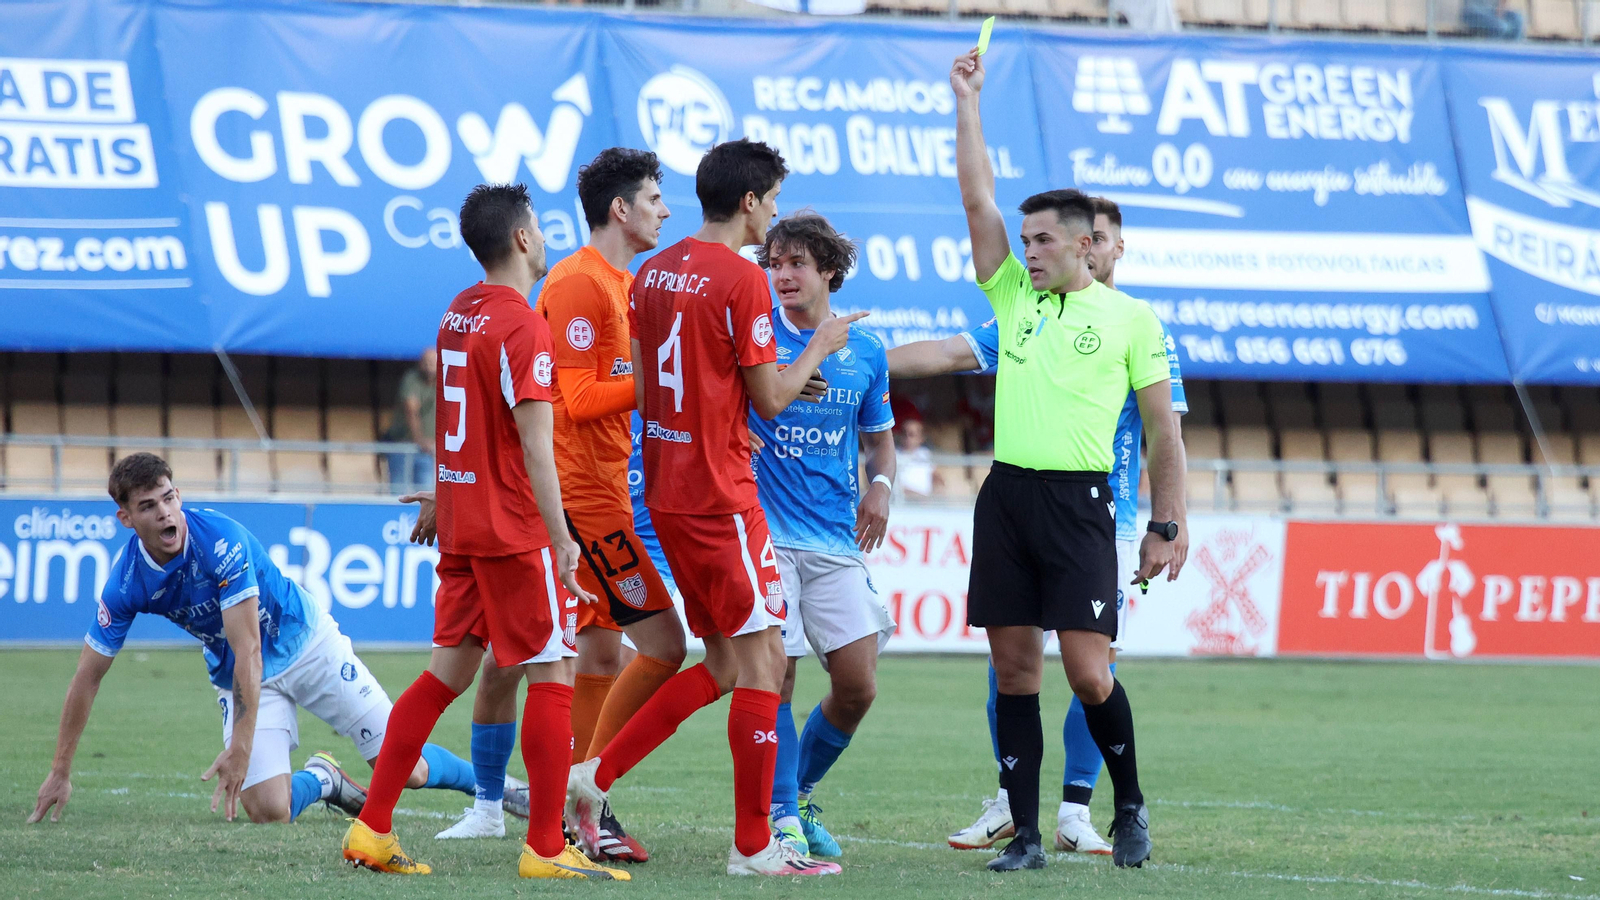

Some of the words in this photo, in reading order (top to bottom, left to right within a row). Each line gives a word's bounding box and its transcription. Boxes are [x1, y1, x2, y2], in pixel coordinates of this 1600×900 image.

[43, 71, 115, 110] DE
[752, 76, 954, 116] RECAMBIOS
[1156, 58, 1257, 138] AT
[1258, 62, 1413, 108] GREEN
[189, 73, 592, 194] GROW
[845, 114, 957, 179] GALVE
[1261, 102, 1413, 144] ENERGY
[1152, 142, 1214, 195] 0,0
[203, 202, 372, 298] UP
[865, 234, 922, 282] 01
[1124, 250, 1262, 274] TALACIONES
[657, 311, 684, 414] 4
[441, 348, 468, 453] 5
[814, 406, 843, 416] Resorts
[774, 423, 847, 446] GROW
[806, 445, 840, 458] Capital
[14, 506, 117, 540] clínicas
[215, 541, 243, 575] SUZUKI
[591, 529, 641, 578] 13
[1315, 569, 1415, 620] TIO
